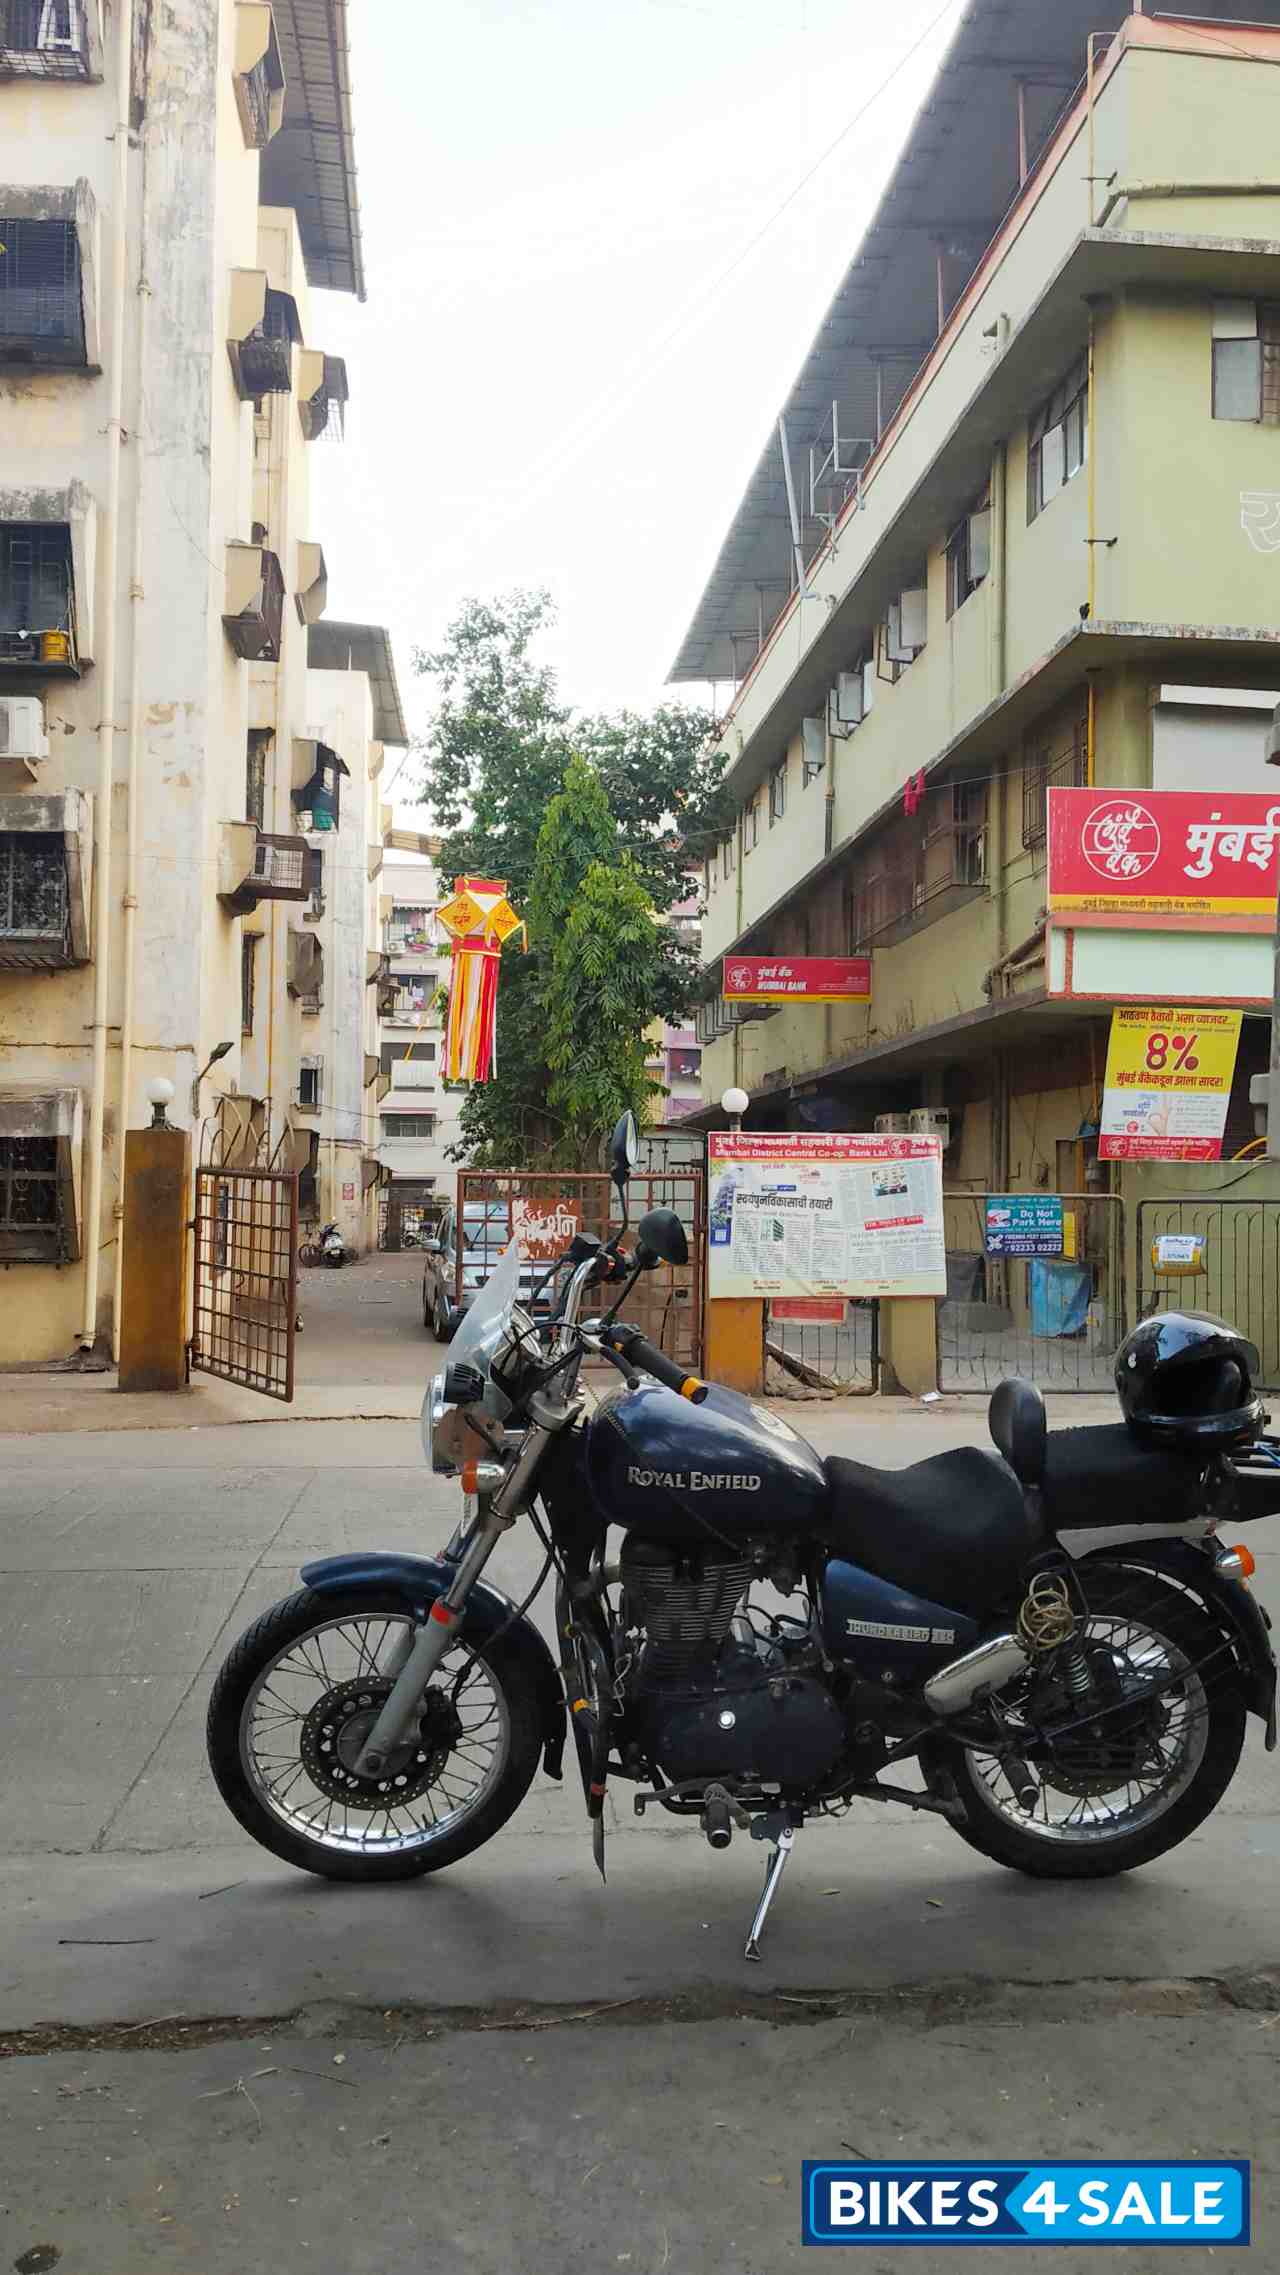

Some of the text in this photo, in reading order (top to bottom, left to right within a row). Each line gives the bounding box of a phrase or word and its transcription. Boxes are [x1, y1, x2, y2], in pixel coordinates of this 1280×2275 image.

[1183, 806, 1280, 879] मुंबई
[757, 981, 807, 991] MUMBAI BANK
[1146, 1033, 1199, 1071] 8%
[716, 1149, 751, 1157] Mumbai
[752, 1149, 784, 1157] District
[784, 1149, 816, 1157] Central
[809, 1196, 833, 1210] तयारी
[1020, 1209, 1054, 1218] Do Not
[1012, 1218, 1036, 1226] Park
[1010, 1243, 1035, 1252] 92233
[628, 1466, 760, 1491] ROYAL ENFIELD
